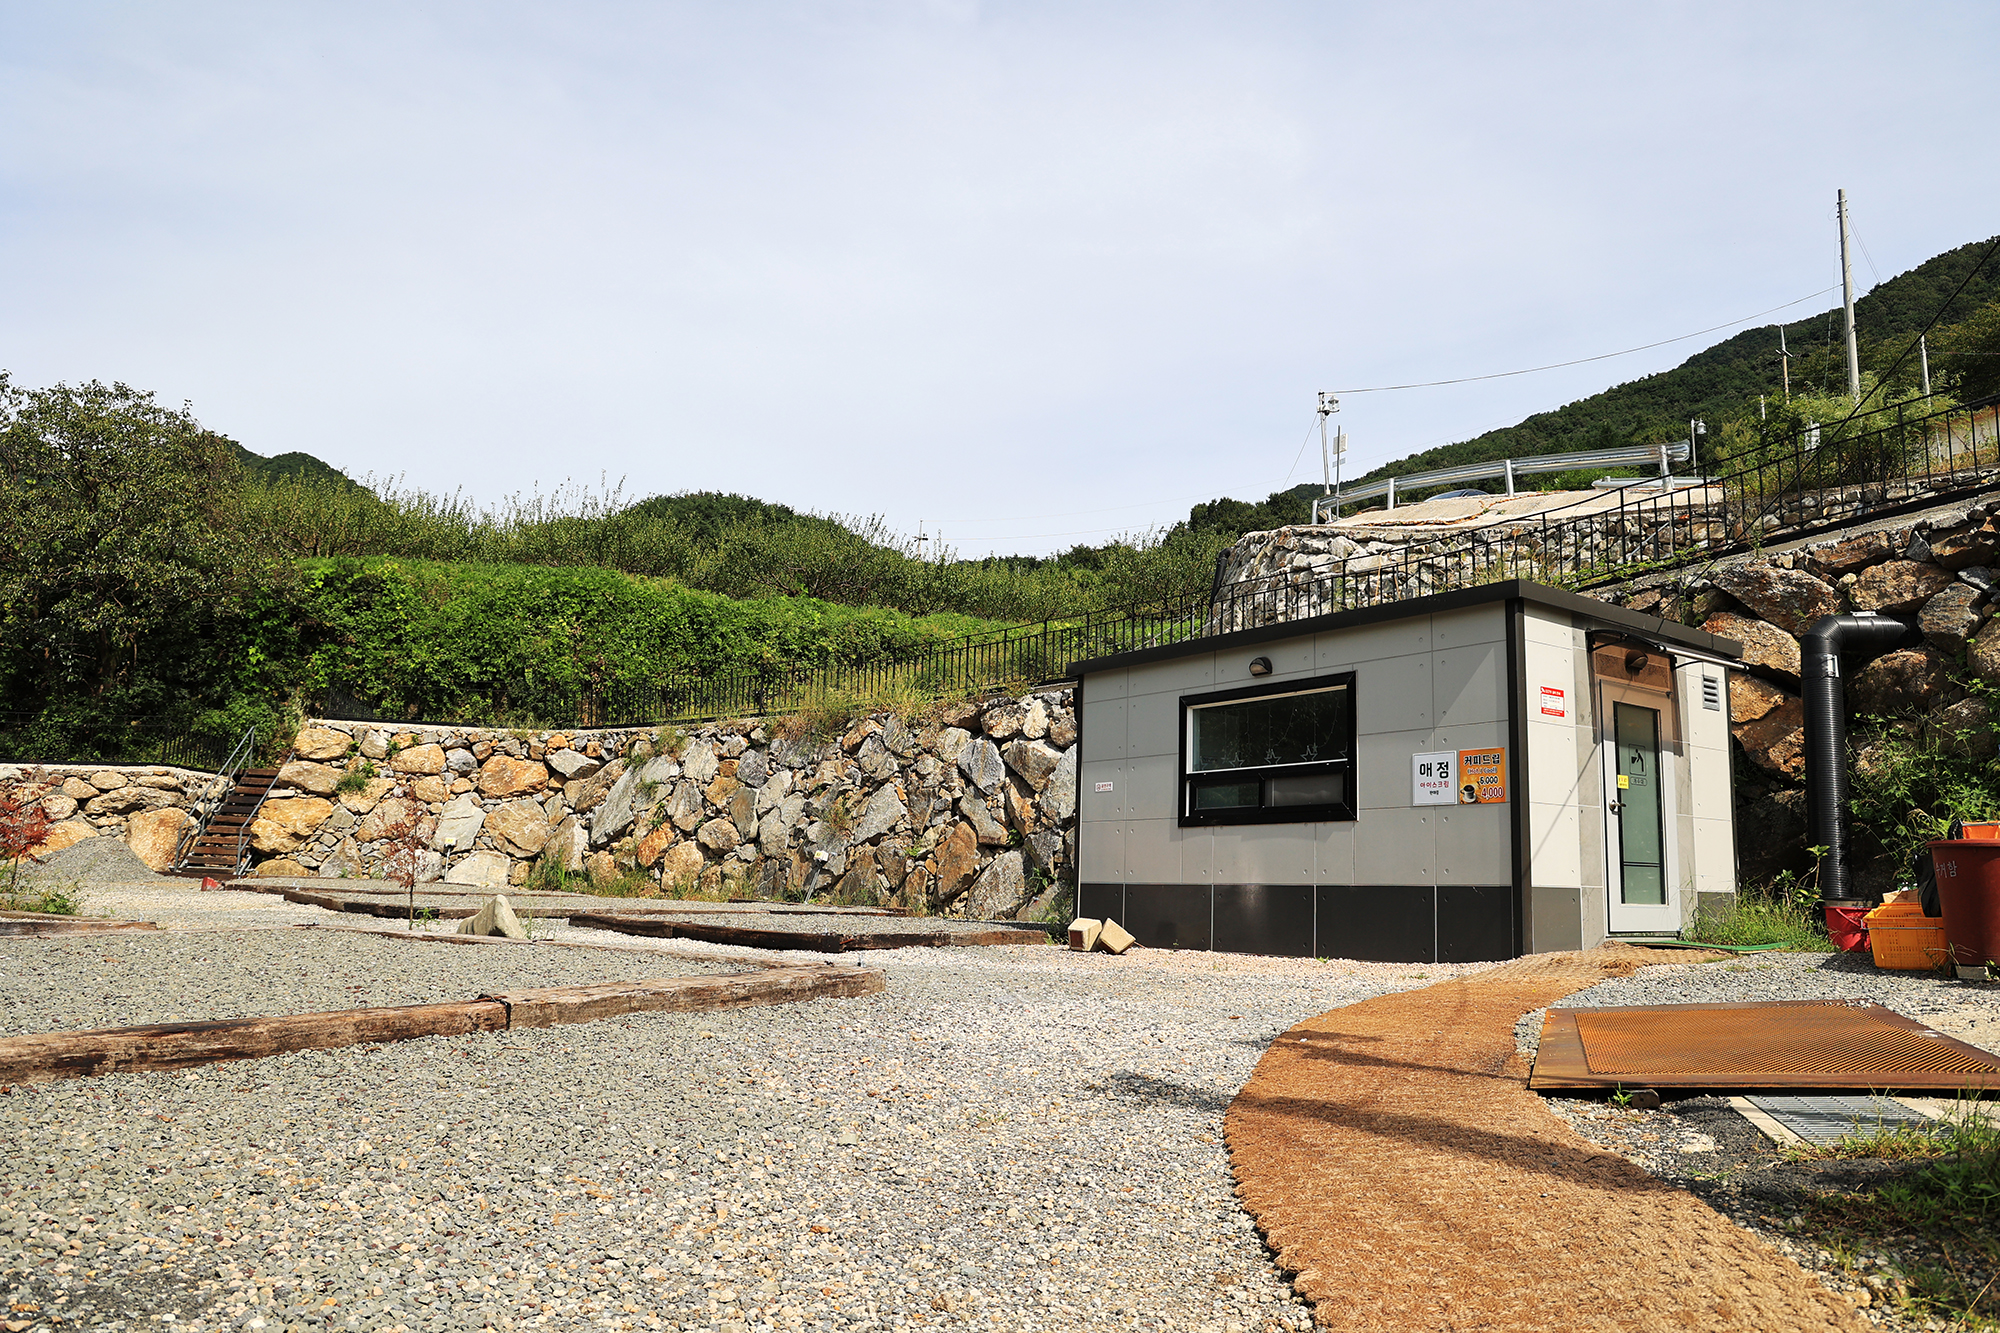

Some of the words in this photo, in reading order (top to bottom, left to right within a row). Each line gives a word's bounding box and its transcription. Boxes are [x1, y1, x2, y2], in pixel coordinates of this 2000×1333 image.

[1464, 753, 1501, 766] 커피드립
[1419, 761, 1449, 779] 매점
[1419, 780, 1450, 789] 아이스크림
[1481, 786, 1504, 800] 4,000
